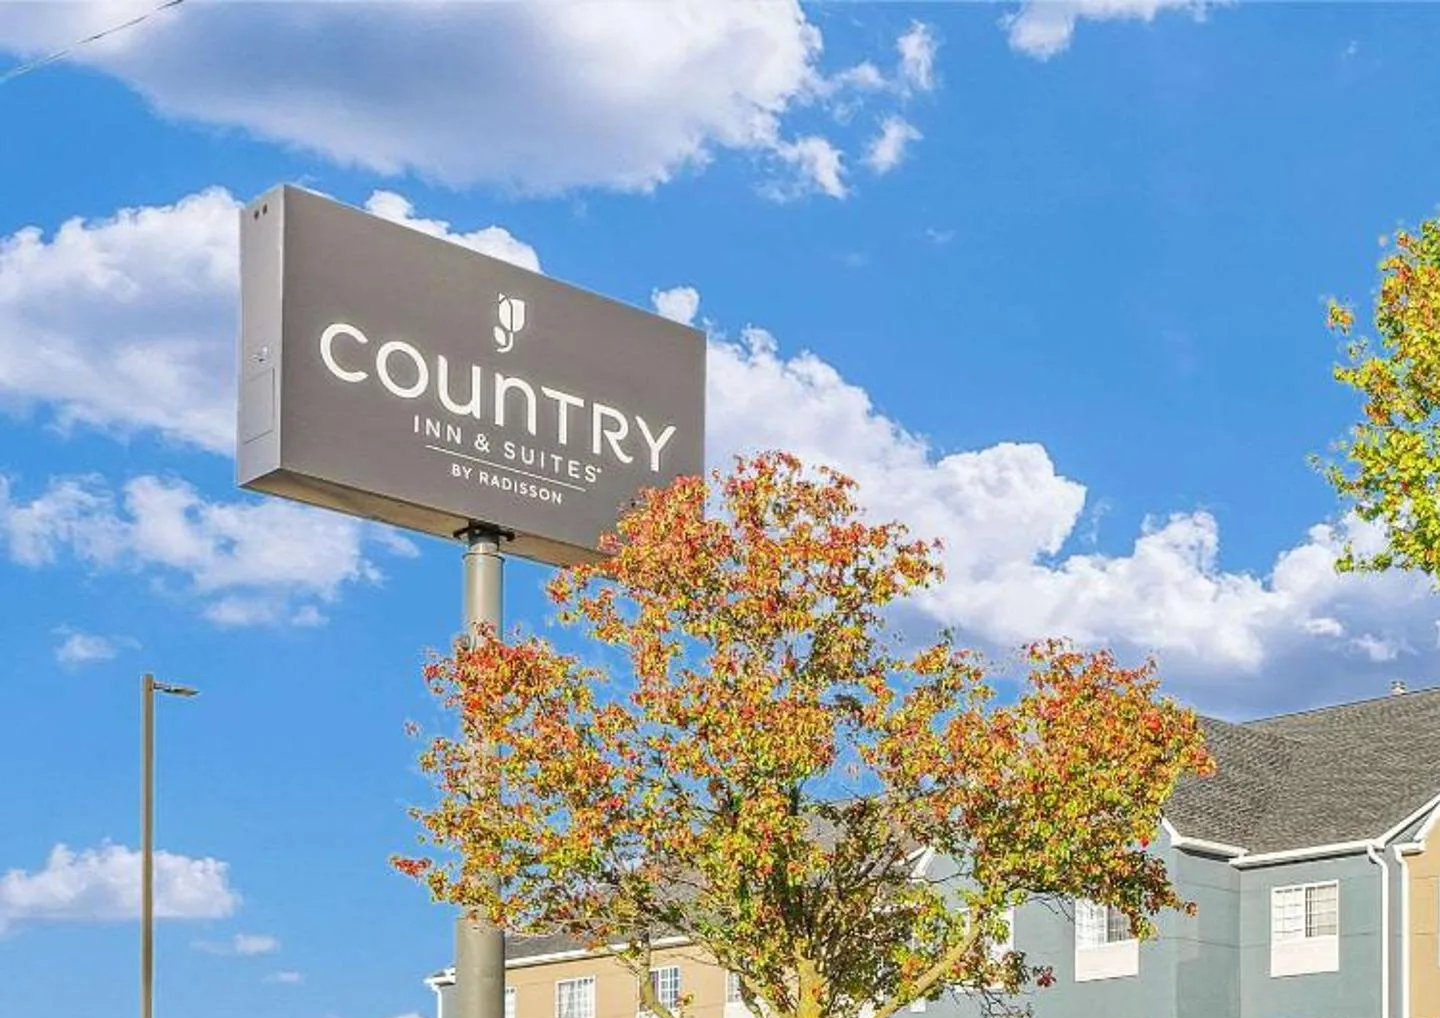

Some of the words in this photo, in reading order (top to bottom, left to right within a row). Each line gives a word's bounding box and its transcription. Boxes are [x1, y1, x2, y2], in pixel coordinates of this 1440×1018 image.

[413, 415, 462, 445] INN
[473, 433, 490, 454] &
[503, 440, 598, 483] SUITES
[451, 463, 473, 480] BY
[479, 470, 562, 505] RADISSON
